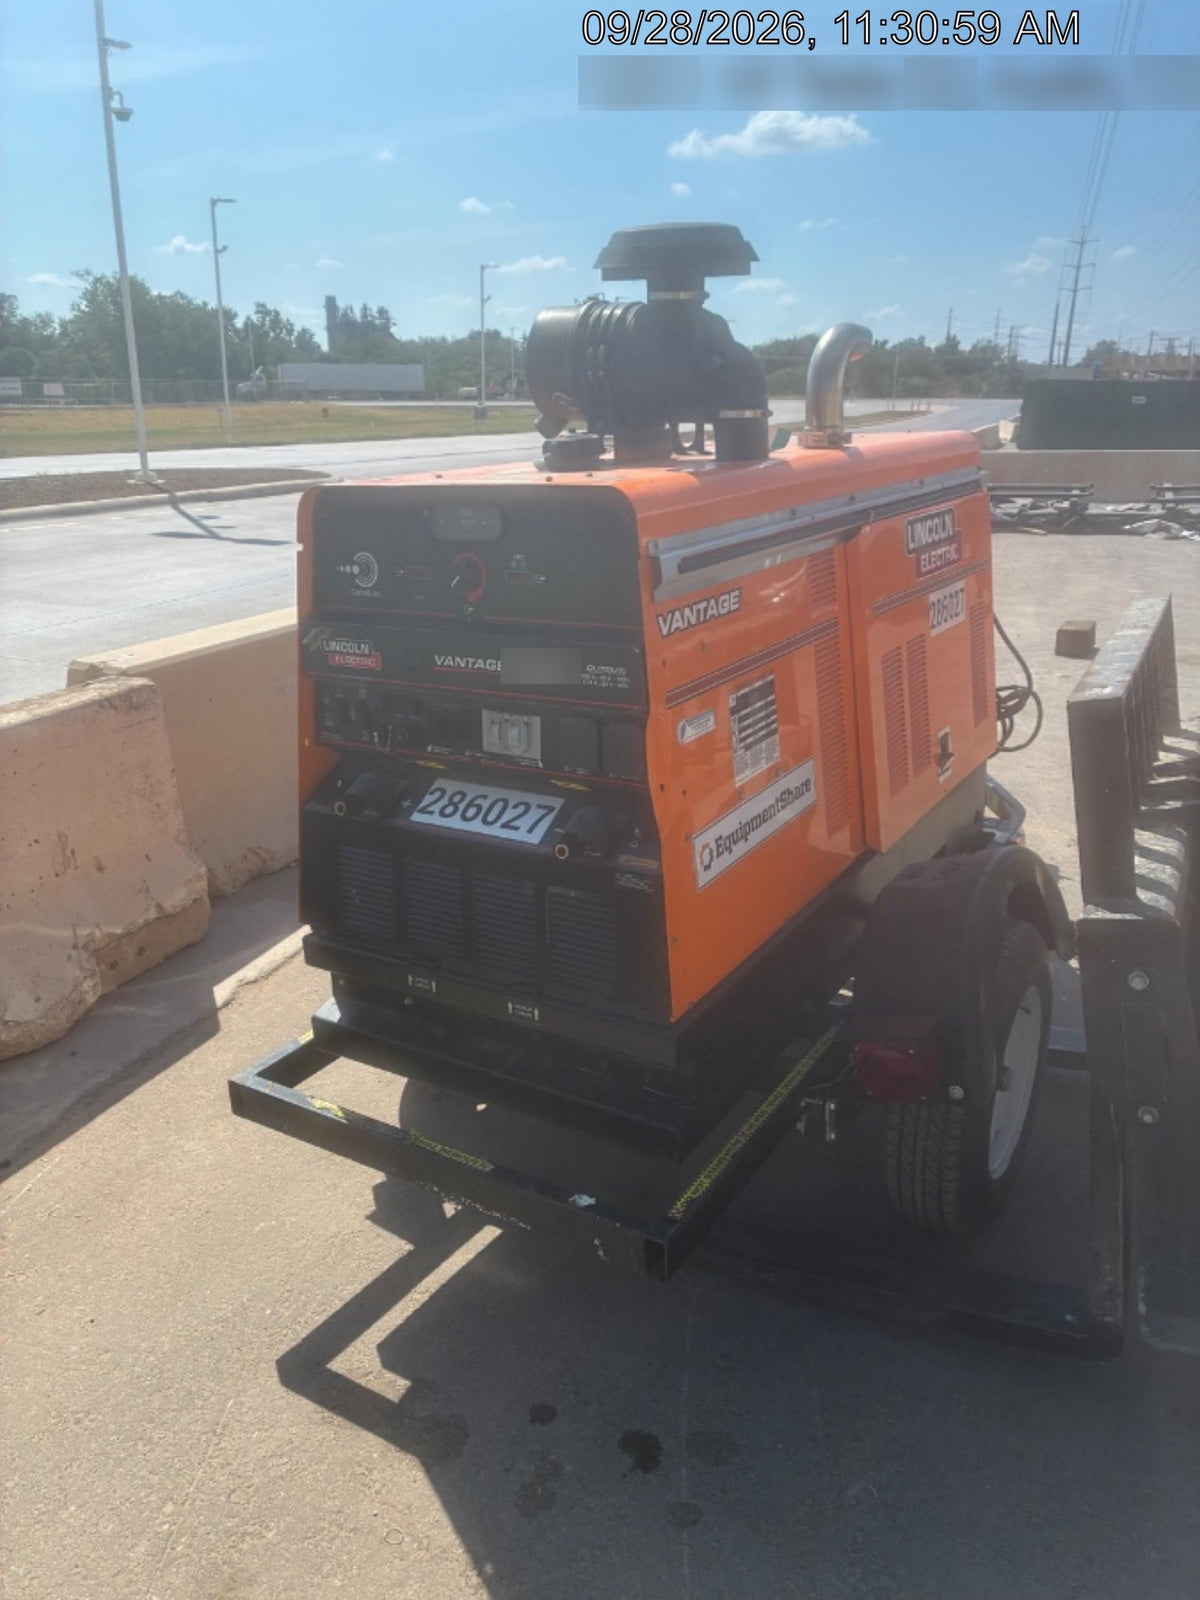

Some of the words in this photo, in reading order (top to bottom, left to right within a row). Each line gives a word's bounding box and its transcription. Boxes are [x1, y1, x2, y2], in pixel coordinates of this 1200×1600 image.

[907, 513, 953, 549] LINCOLN
[920, 544, 959, 572] ELECTRIC
[657, 589, 741, 636] VANTAGE
[929, 589, 965, 628] 286027
[322, 639, 370, 655] LINCOLN
[334, 655, 377, 668] ELECTRIC
[416, 787, 556, 834] 286027
[714, 777, 812, 860] EquipmentShare
